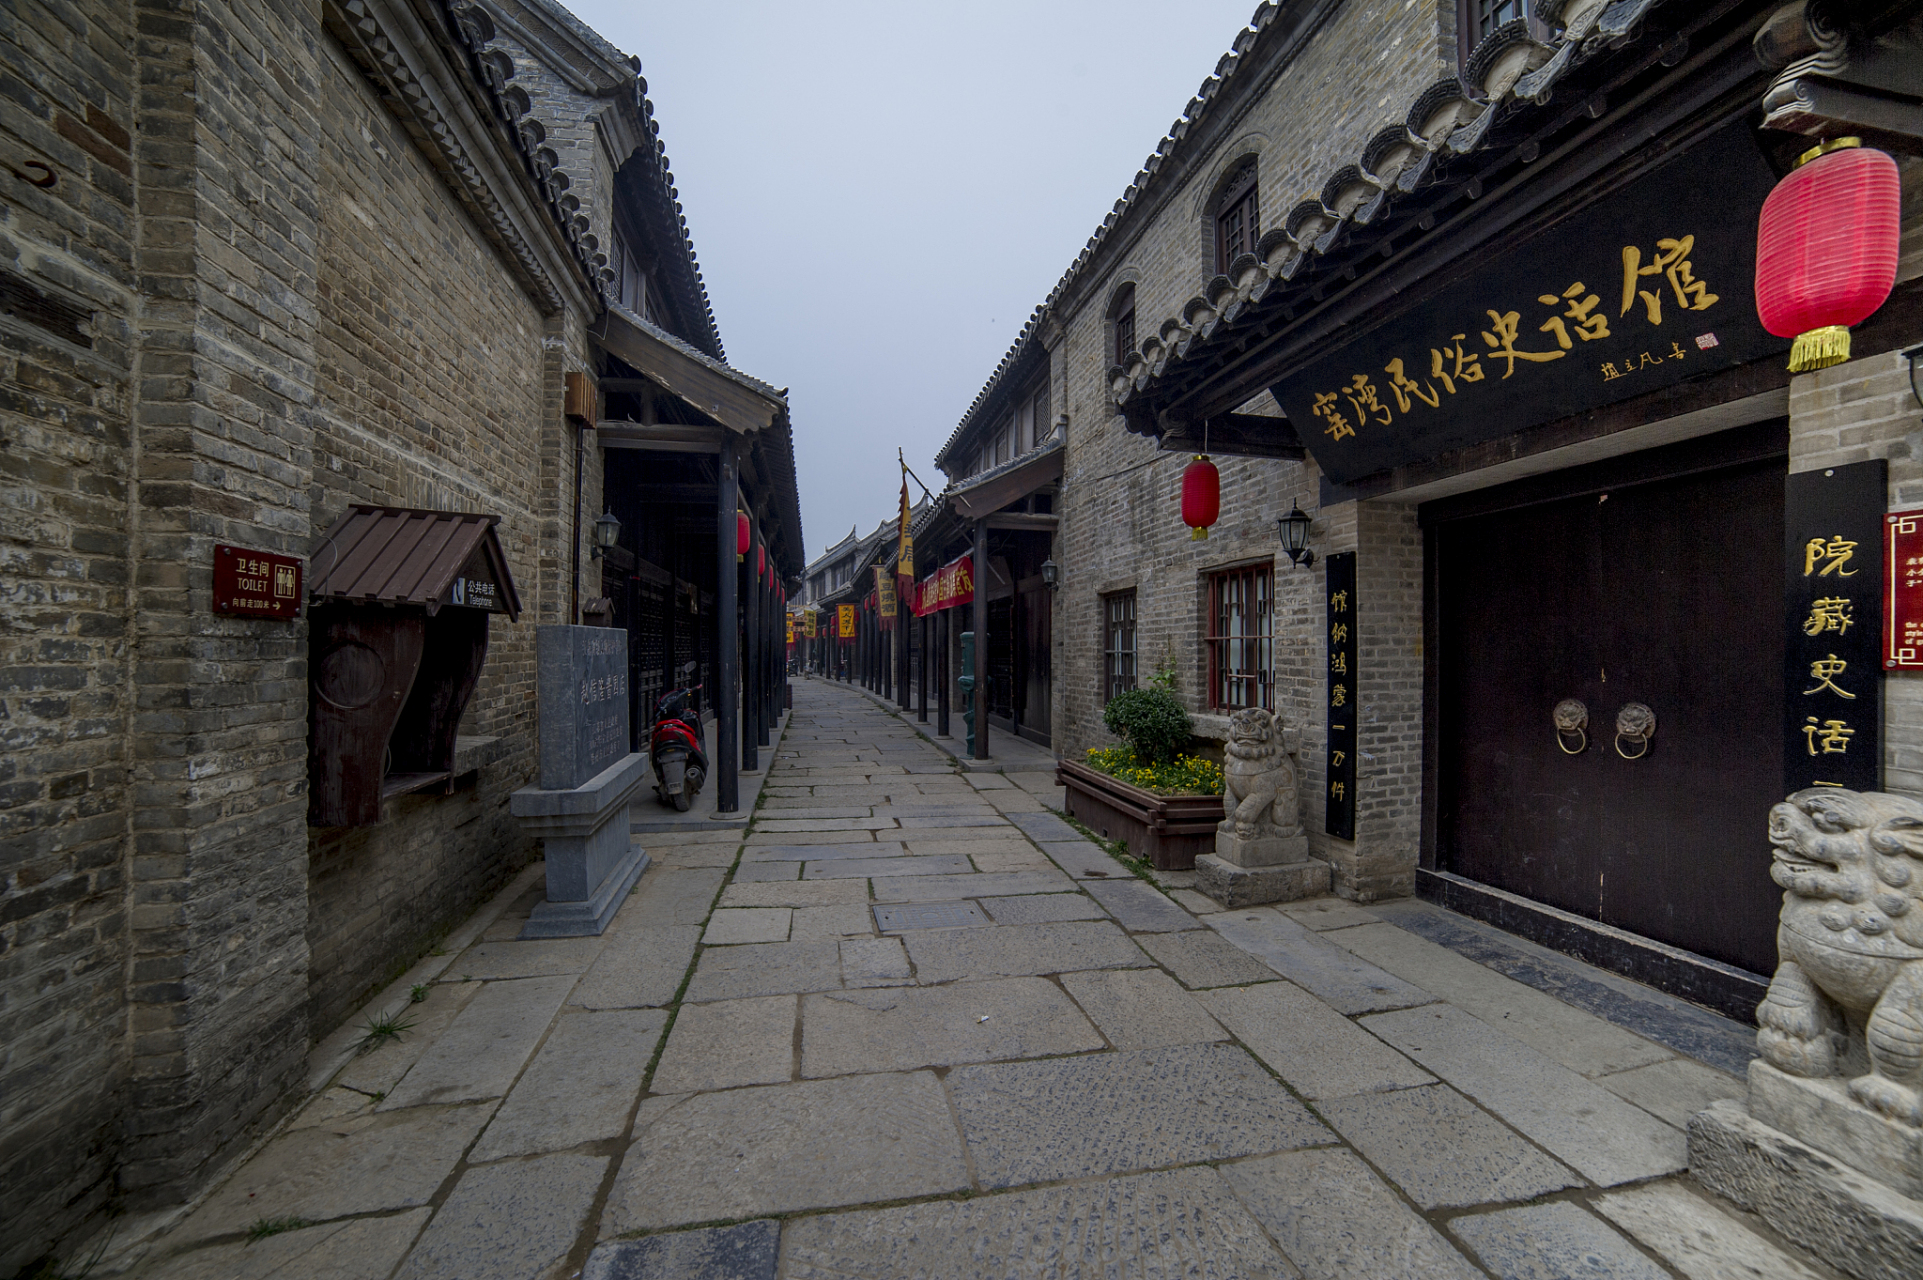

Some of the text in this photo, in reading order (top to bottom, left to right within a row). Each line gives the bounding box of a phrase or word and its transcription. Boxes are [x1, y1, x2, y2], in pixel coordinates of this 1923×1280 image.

[235, 557, 270, 578] 卫生间
[237, 577, 268, 593] TOILET
[467, 580, 495, 596] 公共电话
[232, 597, 270, 609] 向前走100米
[469, 594, 493, 608] Telephone
